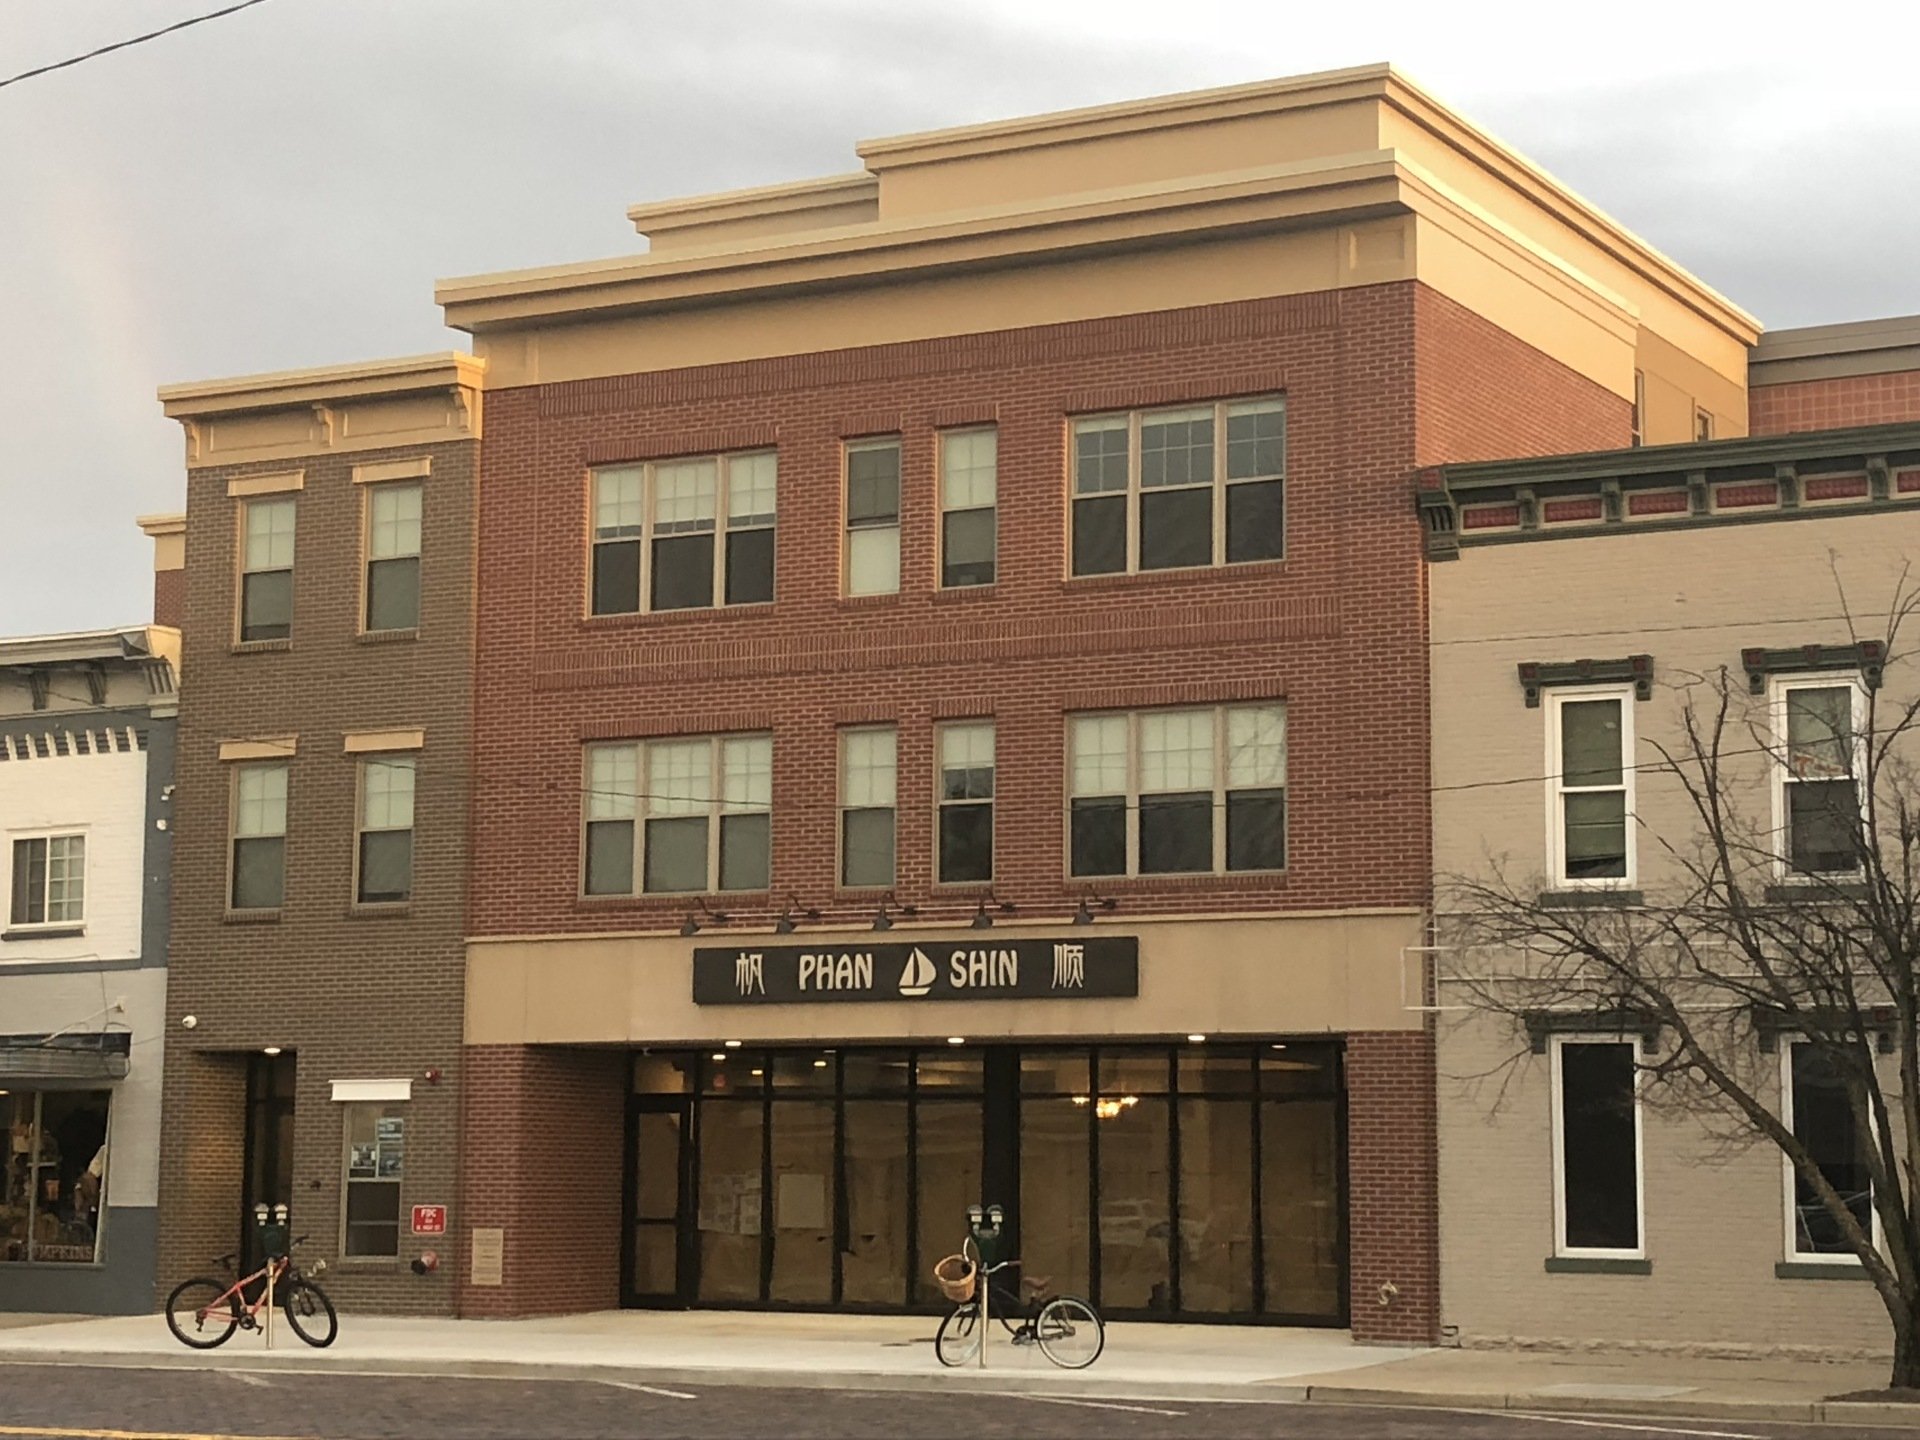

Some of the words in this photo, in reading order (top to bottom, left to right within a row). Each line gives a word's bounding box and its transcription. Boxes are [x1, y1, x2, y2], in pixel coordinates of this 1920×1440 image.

[735, 952, 765, 996] 帆
[799, 953, 873, 990] PHAN
[950, 950, 1018, 988] SHIN
[1051, 943, 1084, 989] 顺
